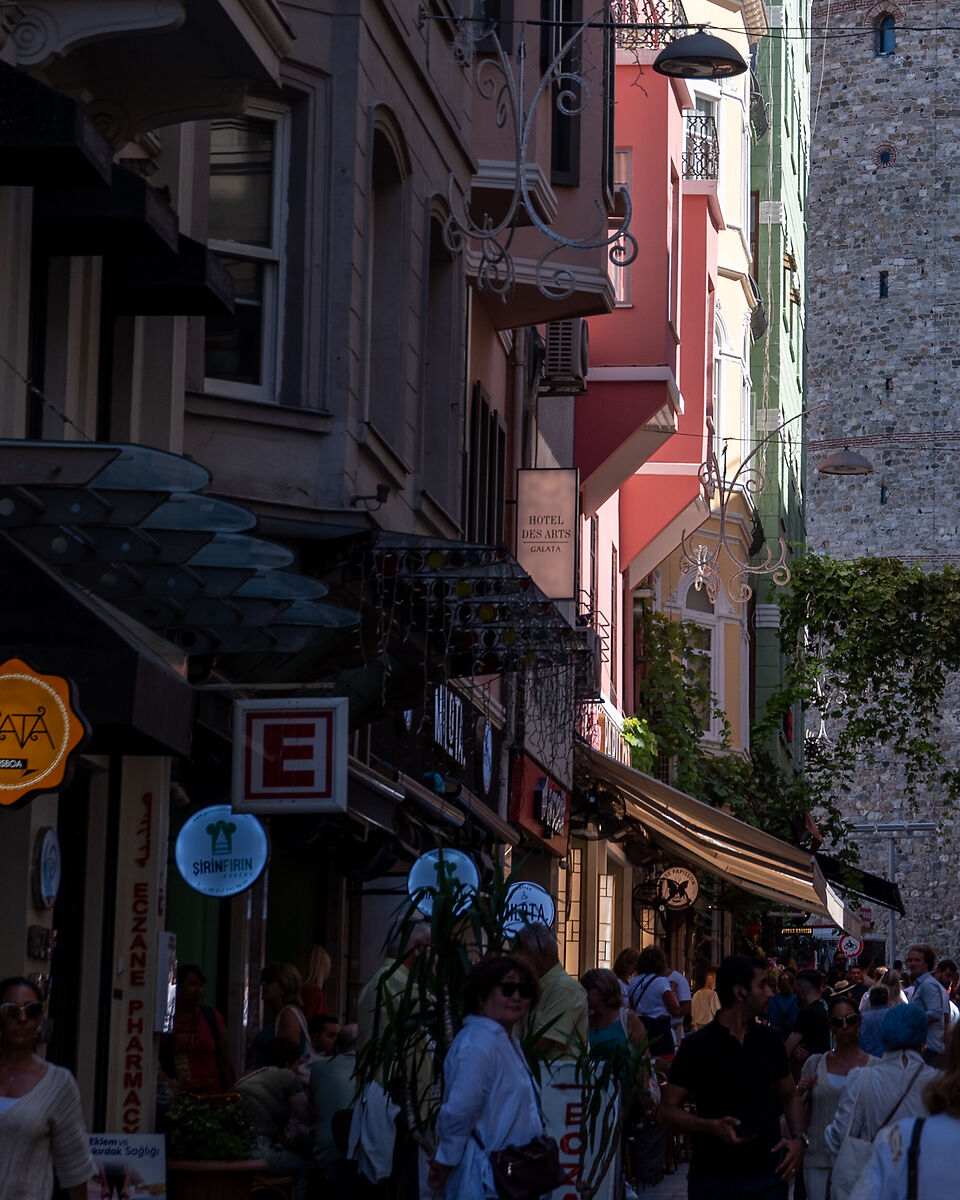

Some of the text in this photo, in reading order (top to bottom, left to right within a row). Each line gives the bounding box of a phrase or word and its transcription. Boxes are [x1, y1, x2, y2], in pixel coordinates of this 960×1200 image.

[528, 515, 564, 525] HOTEL
[521, 529, 571, 539] DES ARTS
[530, 545, 561, 553] GALATA
[0, 706, 56, 750] ATA
[263, 723, 315, 787] E
[129, 883, 148, 987] ECZANE
[88, 1137, 117, 1146] Eklem
[91, 1145, 160, 1158] kırdak Sağlığı
